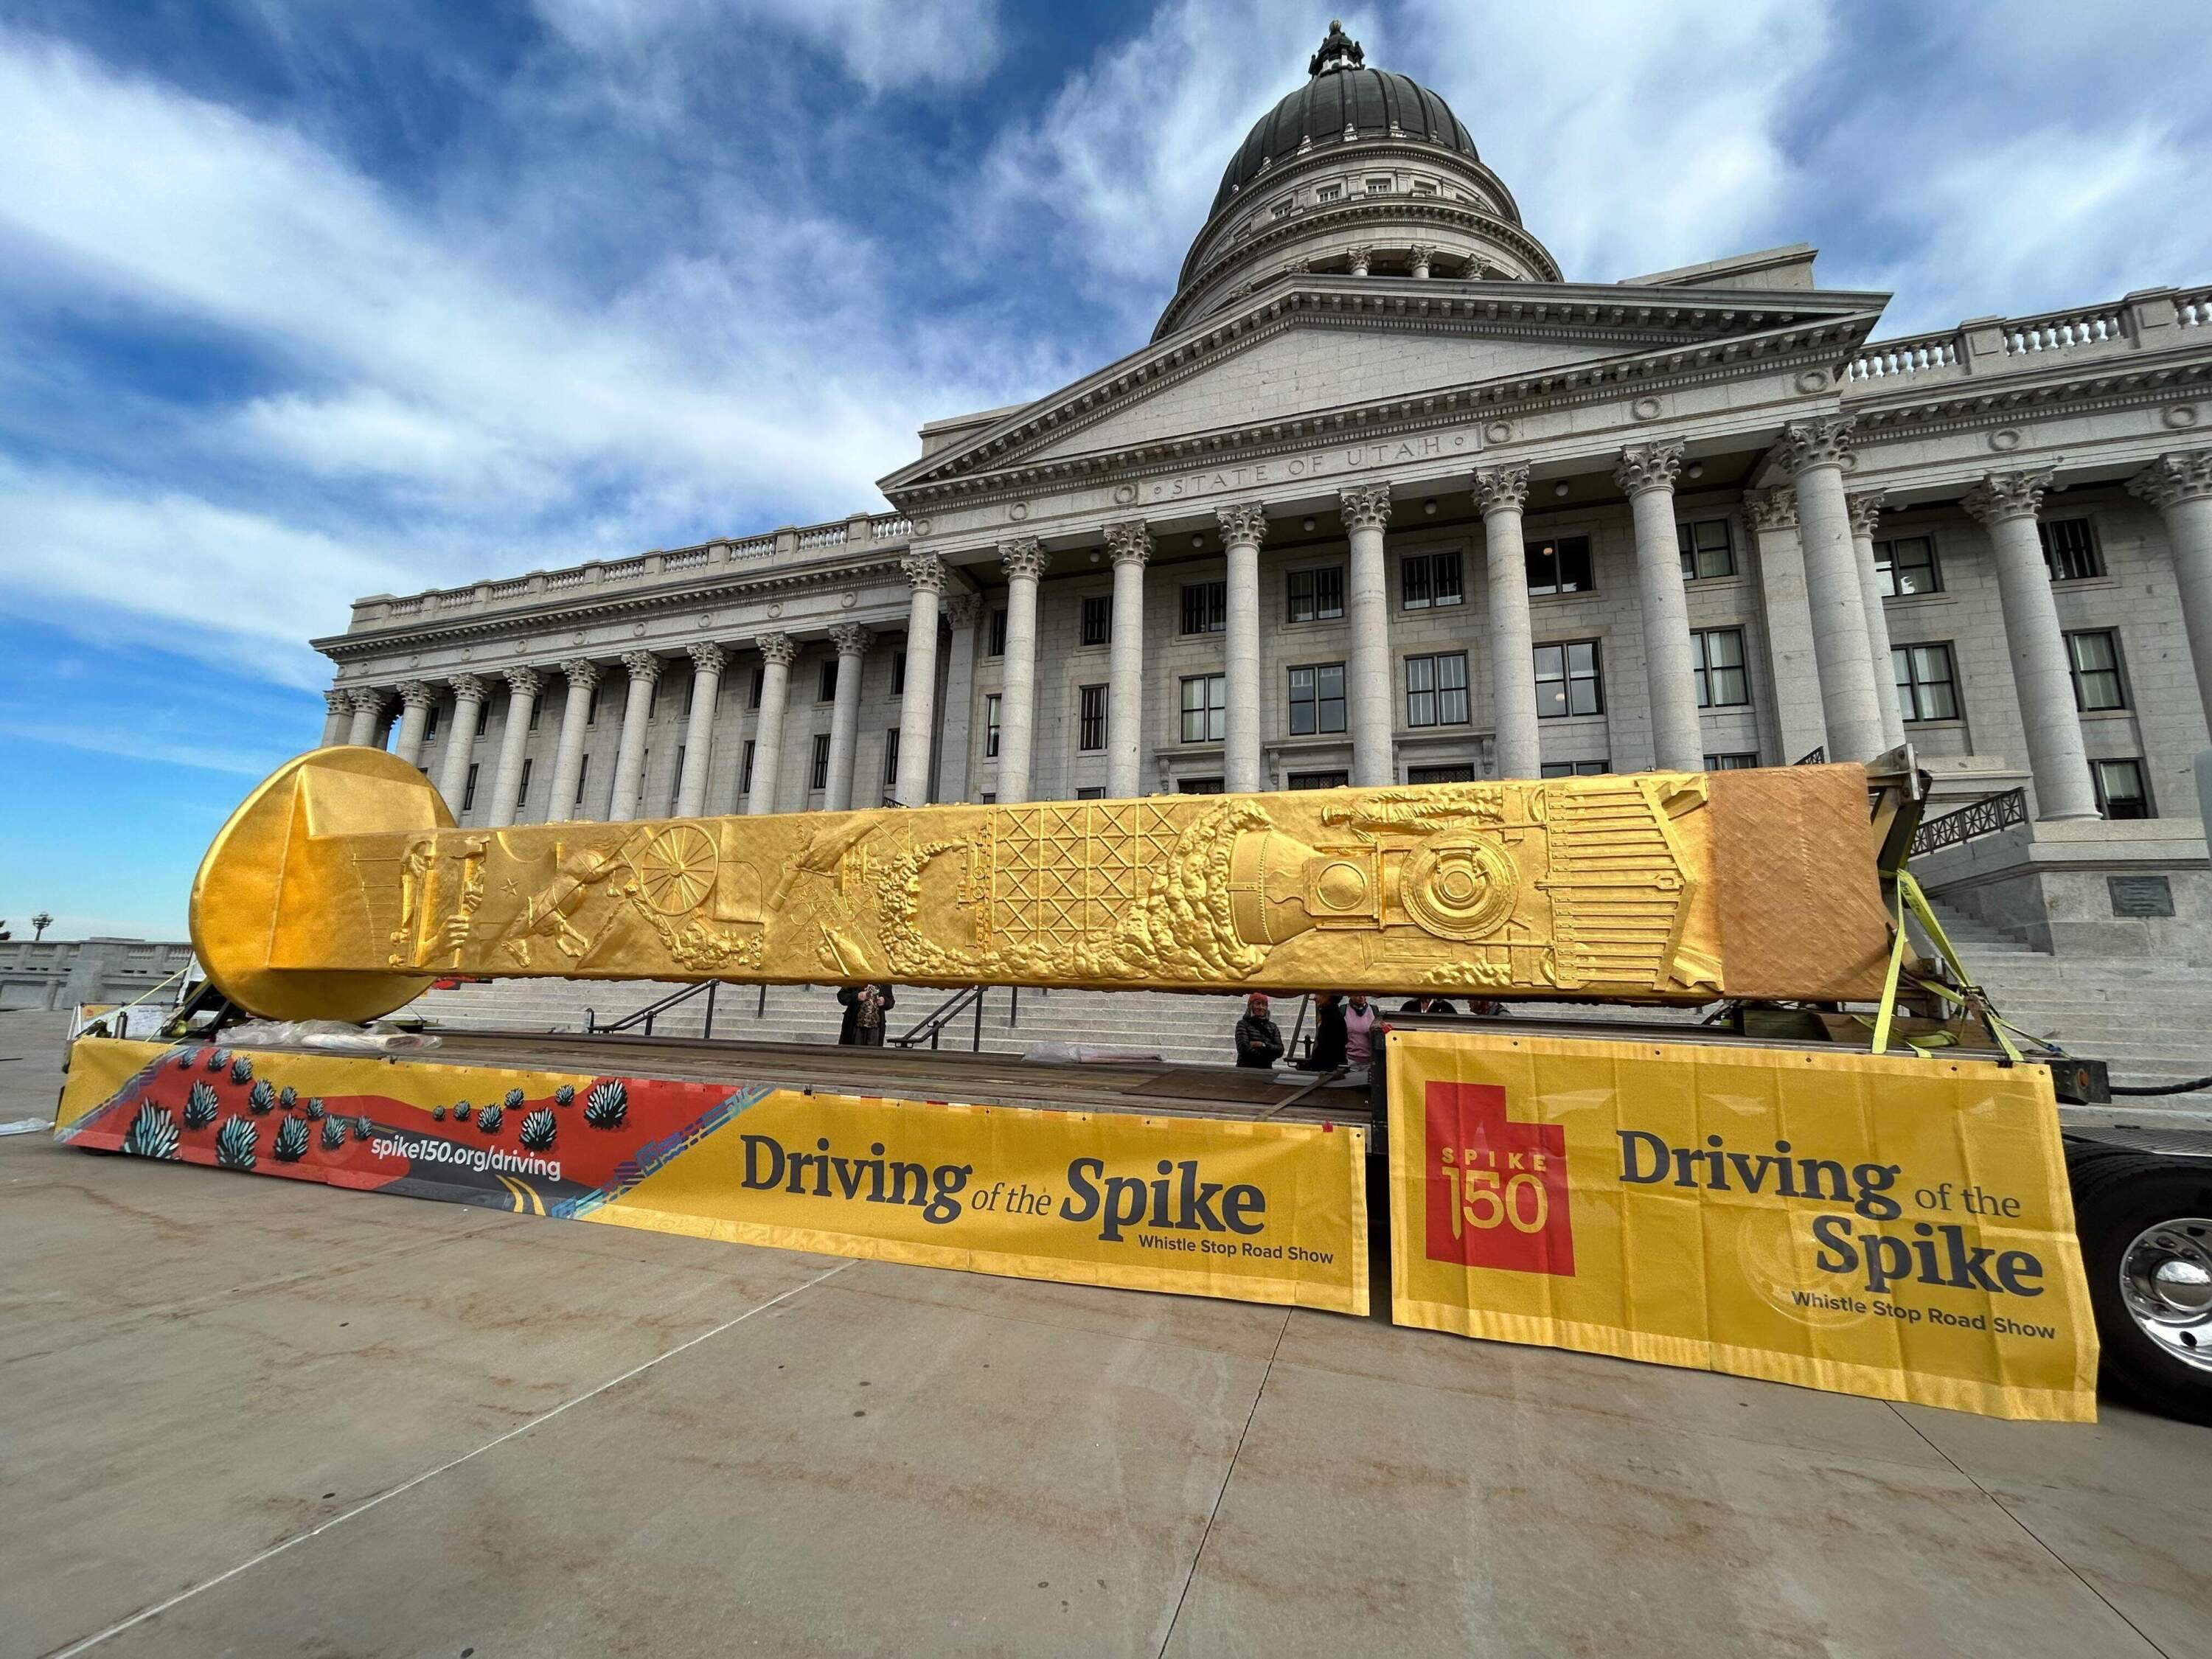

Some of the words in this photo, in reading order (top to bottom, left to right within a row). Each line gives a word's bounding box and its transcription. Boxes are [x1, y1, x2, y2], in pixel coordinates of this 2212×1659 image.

[1172, 465, 1267, 495] STATE
[1288, 456, 1323, 476] OF
[1347, 437, 1440, 466] UTAH
[371, 1135, 561, 1182] spike150.org/driving
[1441, 1147, 1546, 1172] SPIKE
[1616, 1130, 1902, 1221] Driving
[1914, 1183, 1952, 1210] of
[1961, 1186, 2021, 1218] the
[740, 1134, 973, 1224] Driving
[970, 1182, 1005, 1211] of
[1006, 1184, 1052, 1216] the
[1059, 1157, 1266, 1242] Spike
[1441, 1166, 1548, 1240] 150
[1138, 1234, 1196, 1252] Whistle
[1200, 1239, 1237, 1257] Stop
[1242, 1242, 1283, 1259] Road
[1287, 1247, 1335, 1265] Show
[1812, 1215, 2045, 1298] Spike
[1791, 1290, 1868, 1315] Whistle
[1872, 1301, 1922, 1325] Stop
[1928, 1308, 1986, 1331] Road
[1993, 1318, 2056, 1340] Show
